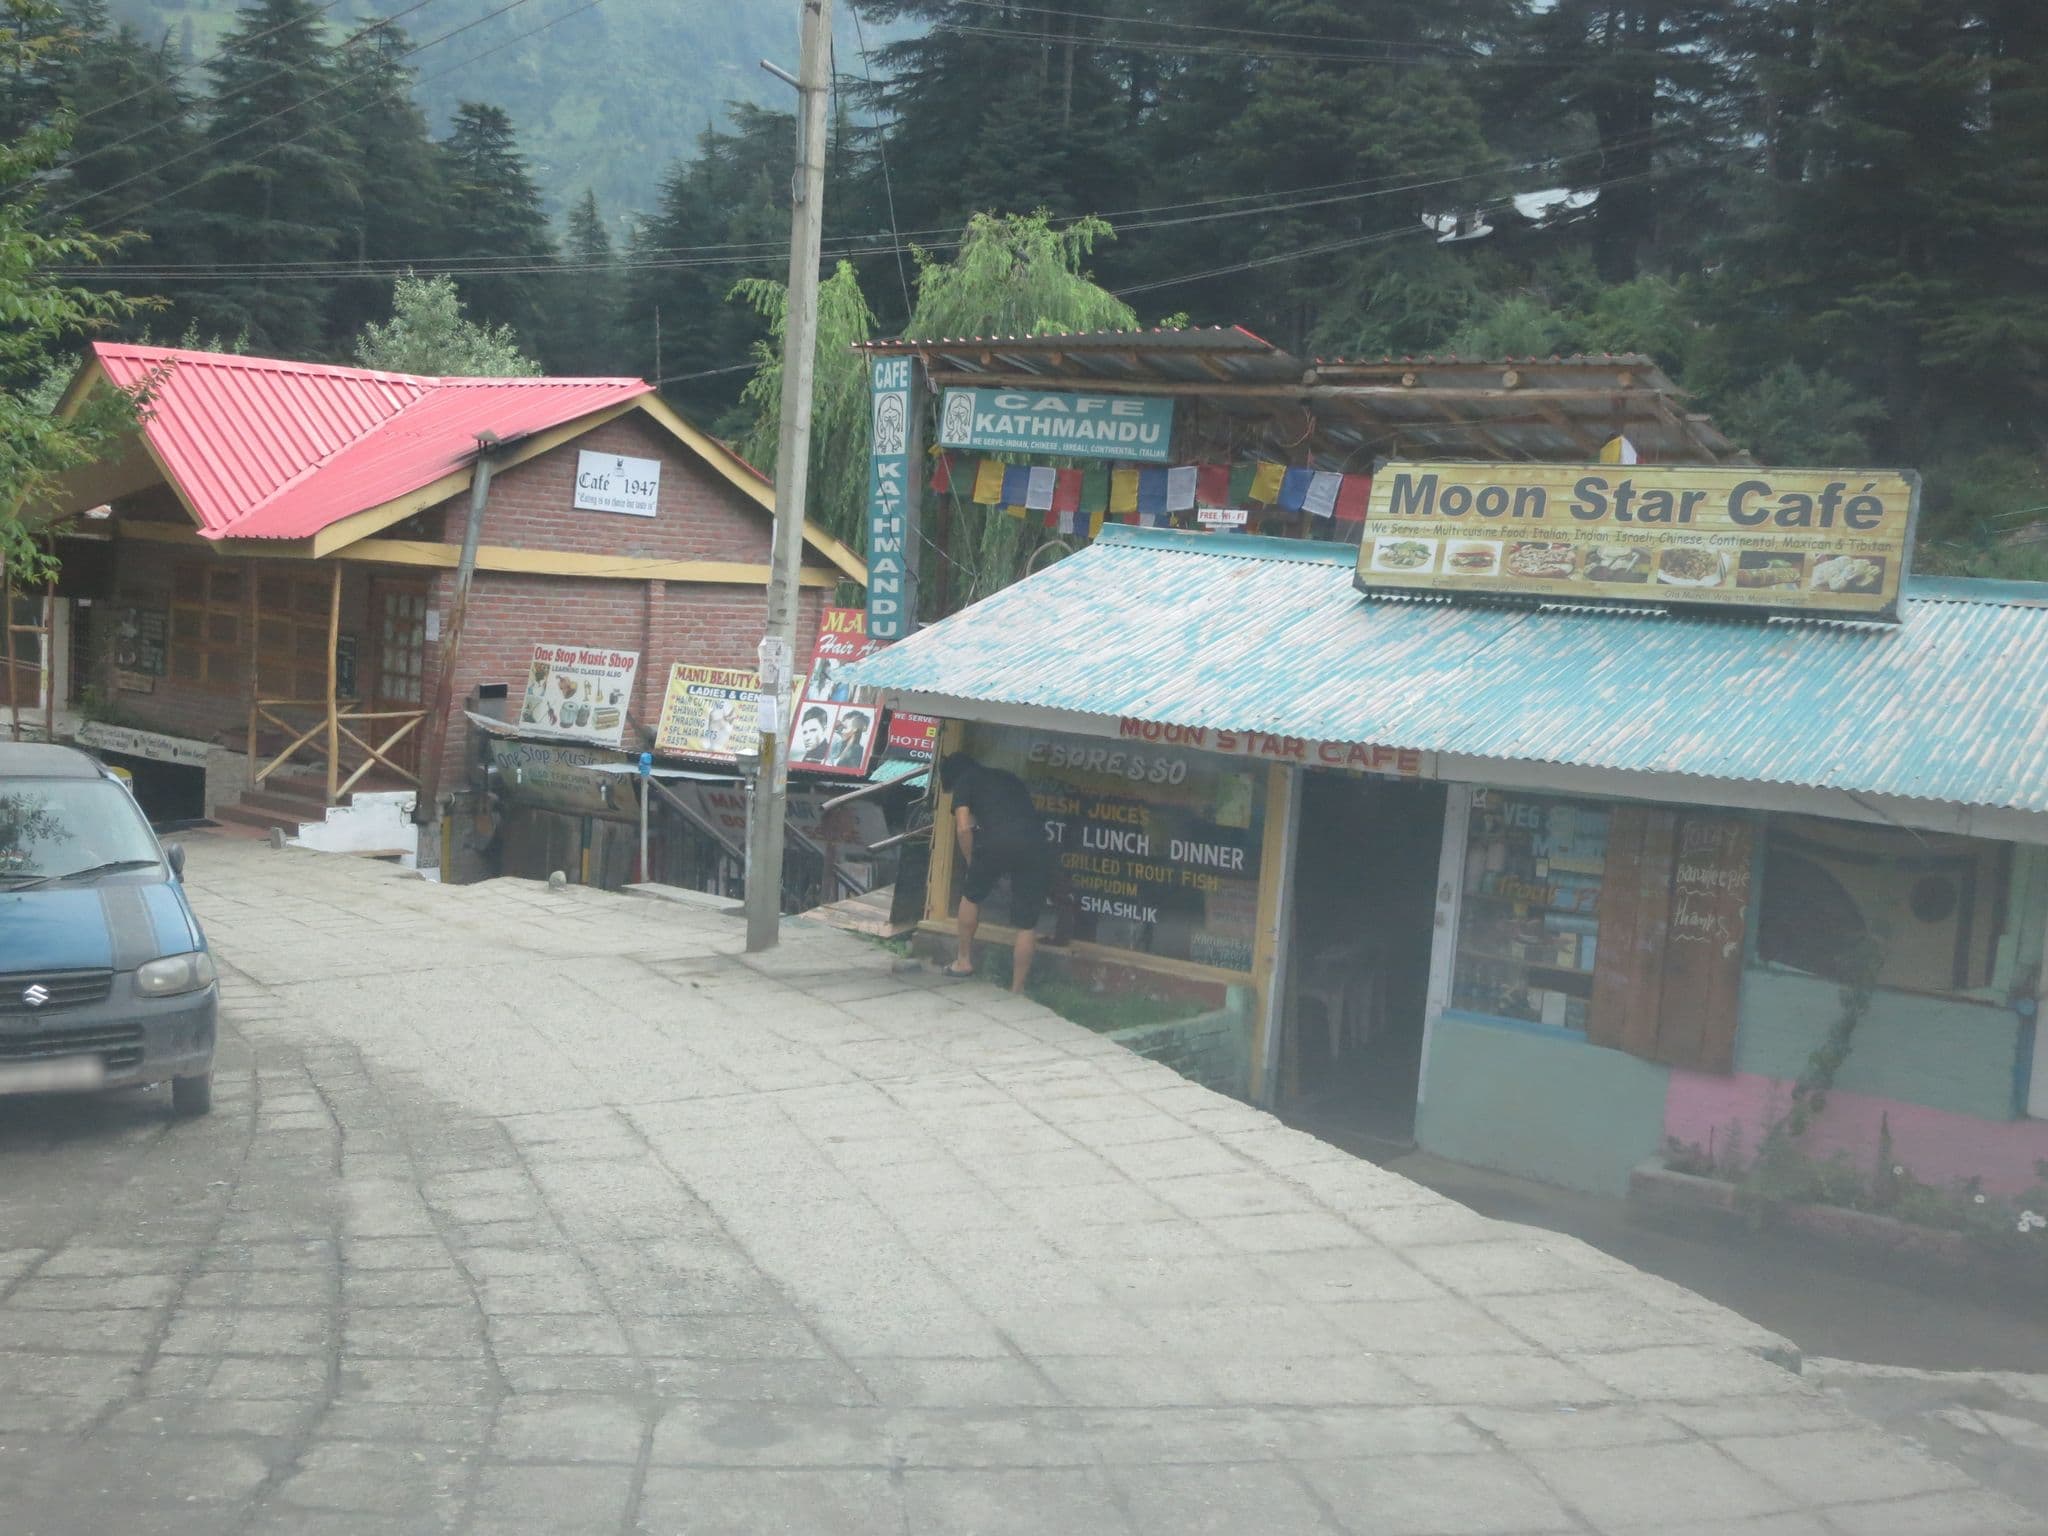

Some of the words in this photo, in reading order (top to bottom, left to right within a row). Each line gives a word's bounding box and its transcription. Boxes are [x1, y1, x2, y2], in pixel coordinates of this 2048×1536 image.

[875, 361, 908, 388] CAFE
[994, 394, 1146, 417] CAFE
[975, 413, 1160, 443] KATHMANDU
[578, 472, 610, 491] Café
[625, 479, 657, 496] 1947
[1389, 473, 1547, 518] Moon
[1569, 476, 1707, 523] Star
[1728, 480, 1884, 530] Café
[1200, 511, 1217, 520] FREE
[1372, 522, 1387, 533] We
[871, 462, 901, 638] KATHMANDU
[822, 611, 867, 635] MA
[820, 634, 855, 656] Hair
[535, 647, 554, 660] One
[555, 649, 576, 667] Stop
[577, 650, 607, 667] Music
[608, 652, 634, 672] Shop
[552, 665, 579, 674] LEARNING
[580, 668, 605, 677] CLASSES
[675, 667, 708, 683] MANU
[710, 669, 753, 688] BEAUTY
[688, 686, 726, 699] LADIES
[728, 689, 737, 699] &
[673, 705, 704, 717] SHAVING
[894, 712, 906, 720] WE
[908, 714, 933, 724] SERVE
[666, 735, 688, 747] RASTA
[1119, 715, 1206, 745] MOON
[1216, 729, 1305, 758] STAR
[1318, 741, 1421, 772] CAFE
[498, 752, 519, 768] One
[520, 745, 551, 764] Stop
[1028, 743, 1188, 785] ESPRESSO
[1083, 826, 1150, 857] LUNCH
[1170, 839, 1244, 871] DINNER
[1062, 852, 1121, 874] GRILLED
[1127, 862, 1174, 884] TROUT
[1182, 872, 1219, 892] FISH
[1071, 874, 1138, 897] SHIPUDIM
[1081, 896, 1158, 924] SHASHLIK
